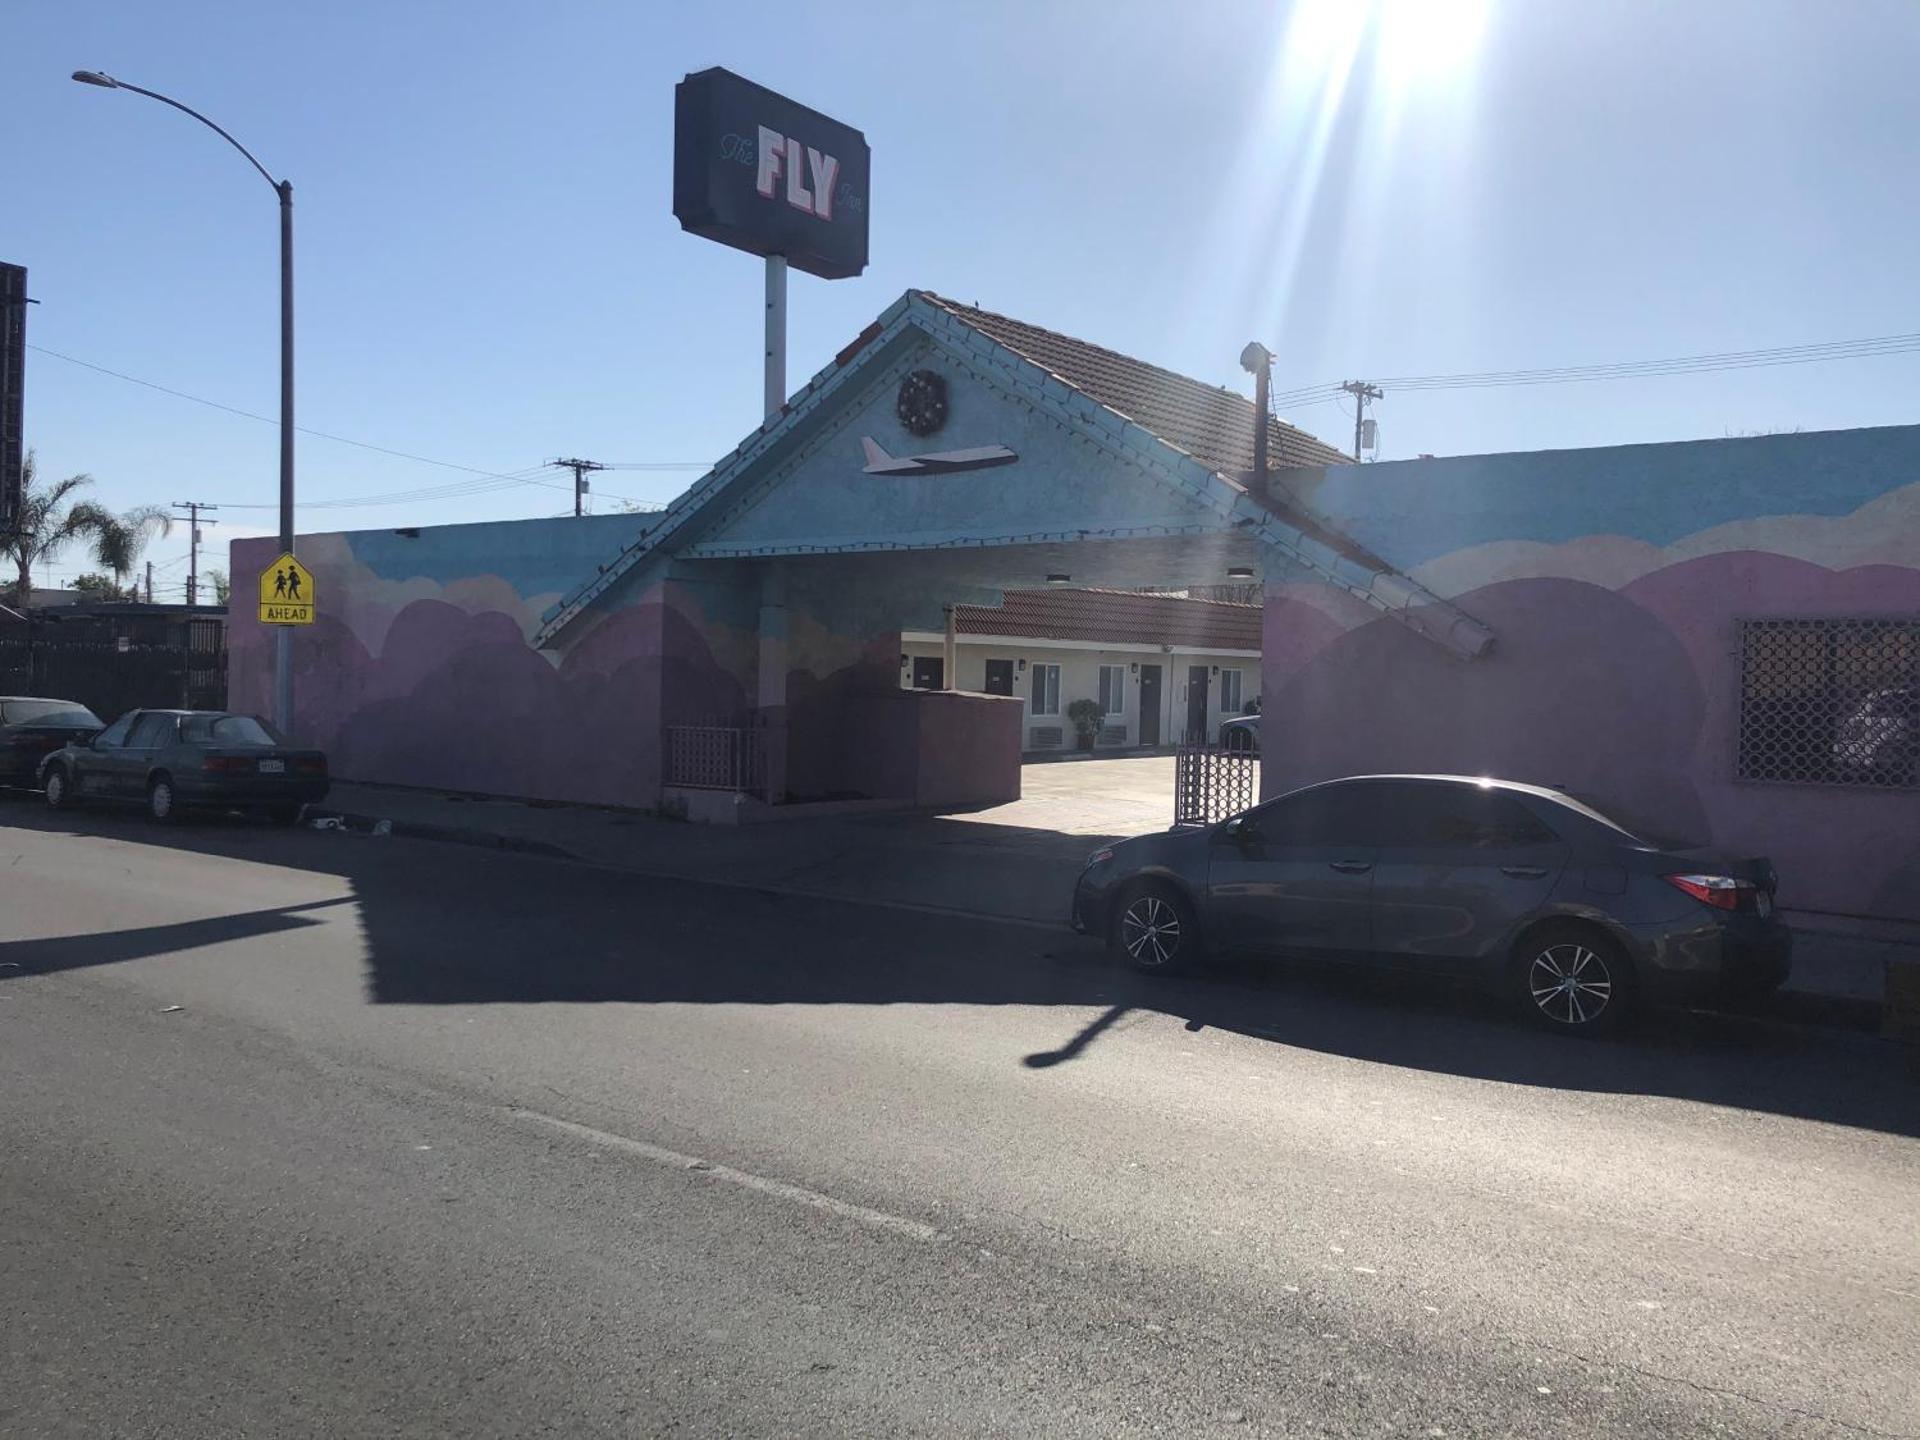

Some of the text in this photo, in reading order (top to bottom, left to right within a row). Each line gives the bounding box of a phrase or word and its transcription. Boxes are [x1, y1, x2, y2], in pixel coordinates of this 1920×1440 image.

[721, 134, 753, 165] The
[757, 125, 839, 221] FLY
[268, 608, 307, 620] AHEAD
